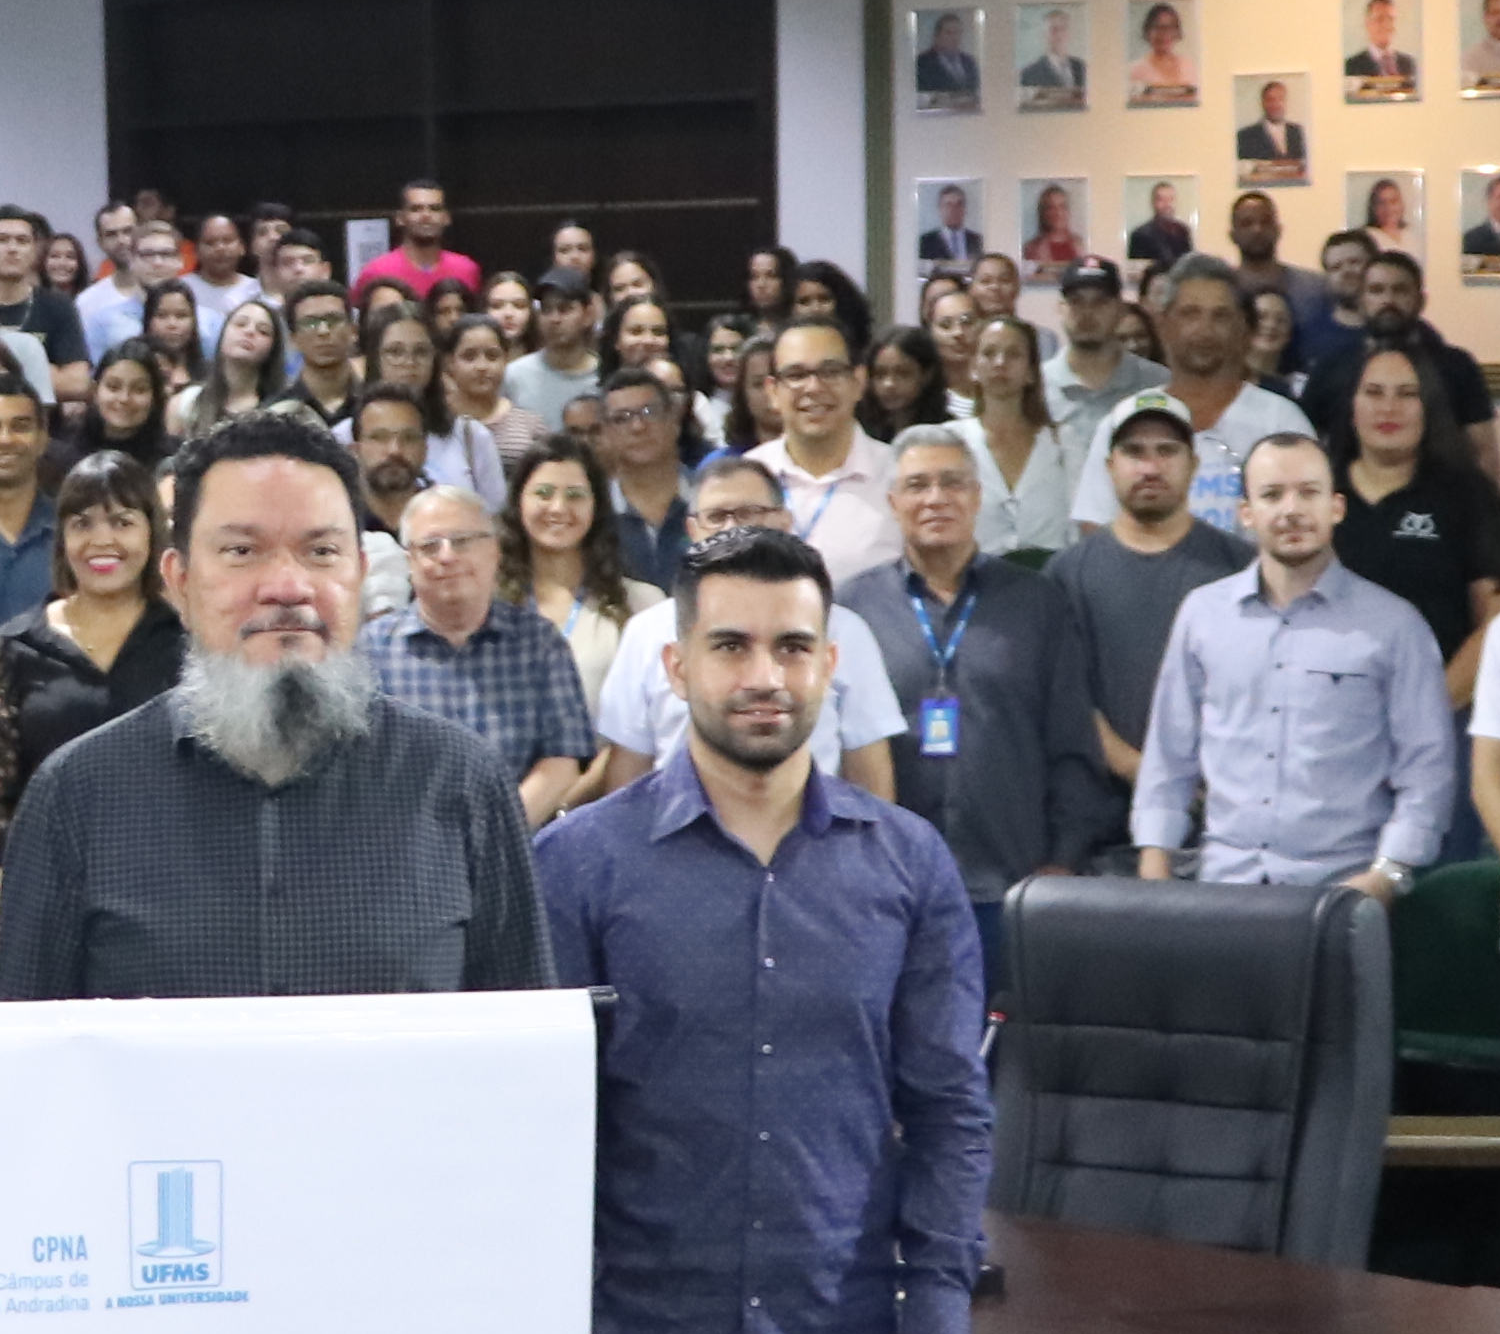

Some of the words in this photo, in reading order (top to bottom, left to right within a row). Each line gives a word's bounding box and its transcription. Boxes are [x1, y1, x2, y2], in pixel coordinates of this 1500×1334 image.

[32, 1234, 89, 1263] CPNA
[69, 1271, 90, 1289] de
[141, 1263, 210, 1284] UFMS
[4, 1295, 91, 1315] Andradina
[105, 1297, 114, 1309] A
[117, 1294, 155, 1309] NOSSA
[158, 1290, 249, 1306] UNIVERSIDADE
